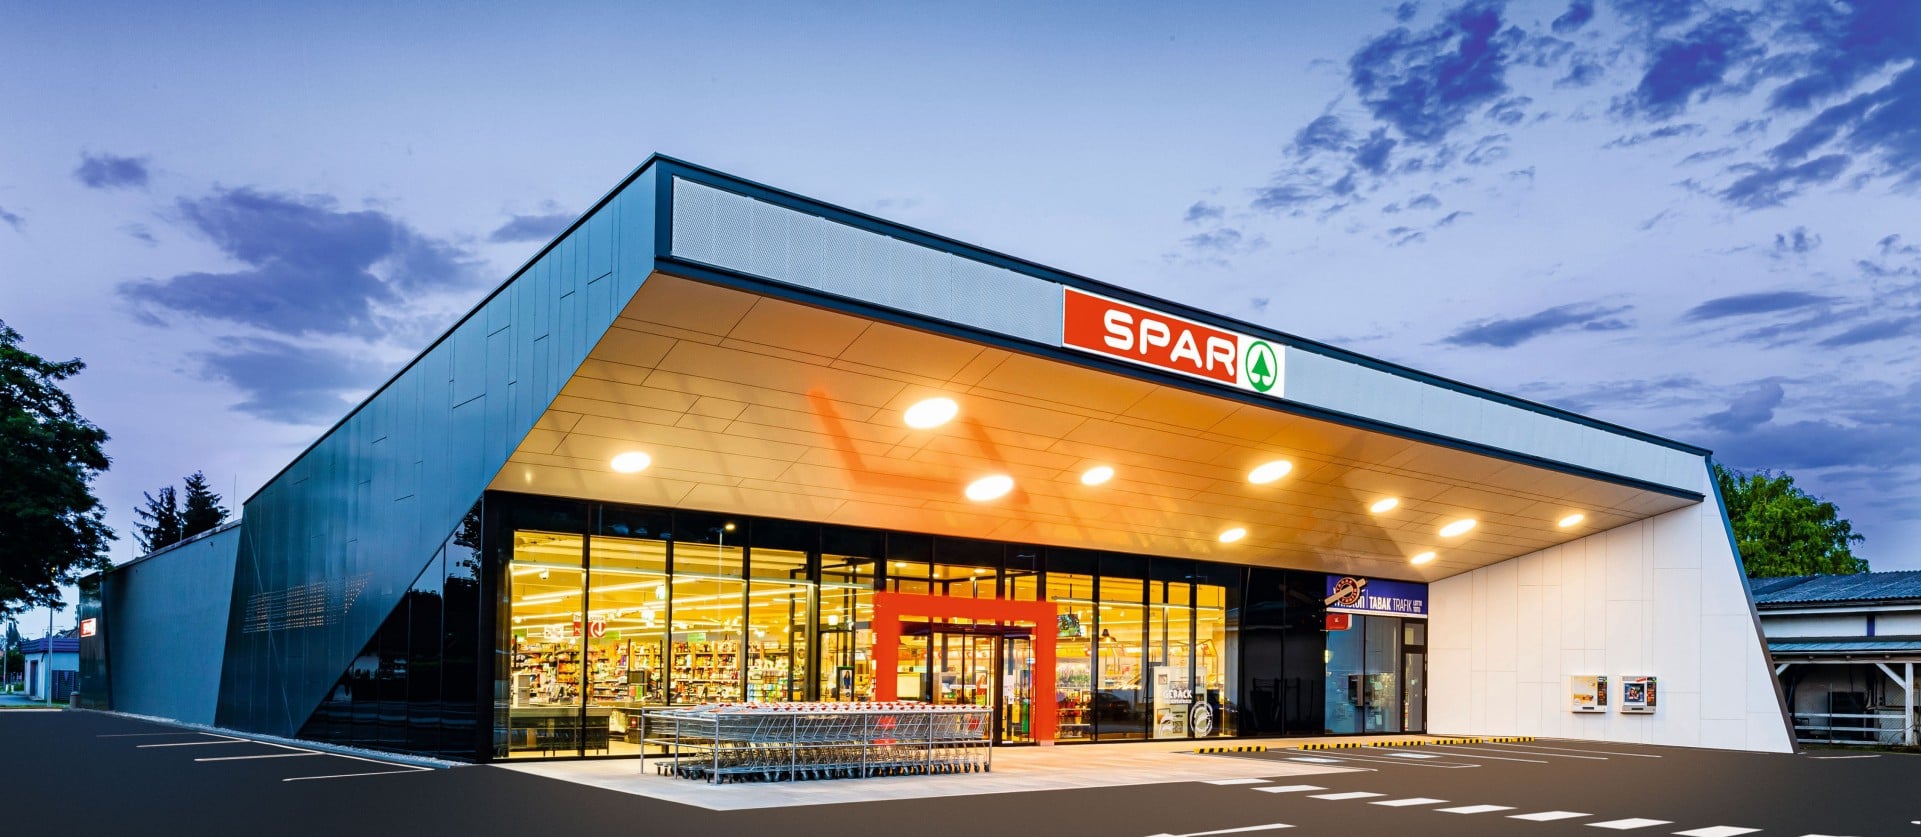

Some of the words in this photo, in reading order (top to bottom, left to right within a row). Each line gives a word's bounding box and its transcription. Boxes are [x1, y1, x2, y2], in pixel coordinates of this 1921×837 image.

[1104, 309, 1236, 376] SPAR
[1369, 596, 1391, 610] TABAK
[1393, 598, 1413, 612] TRAFIK
